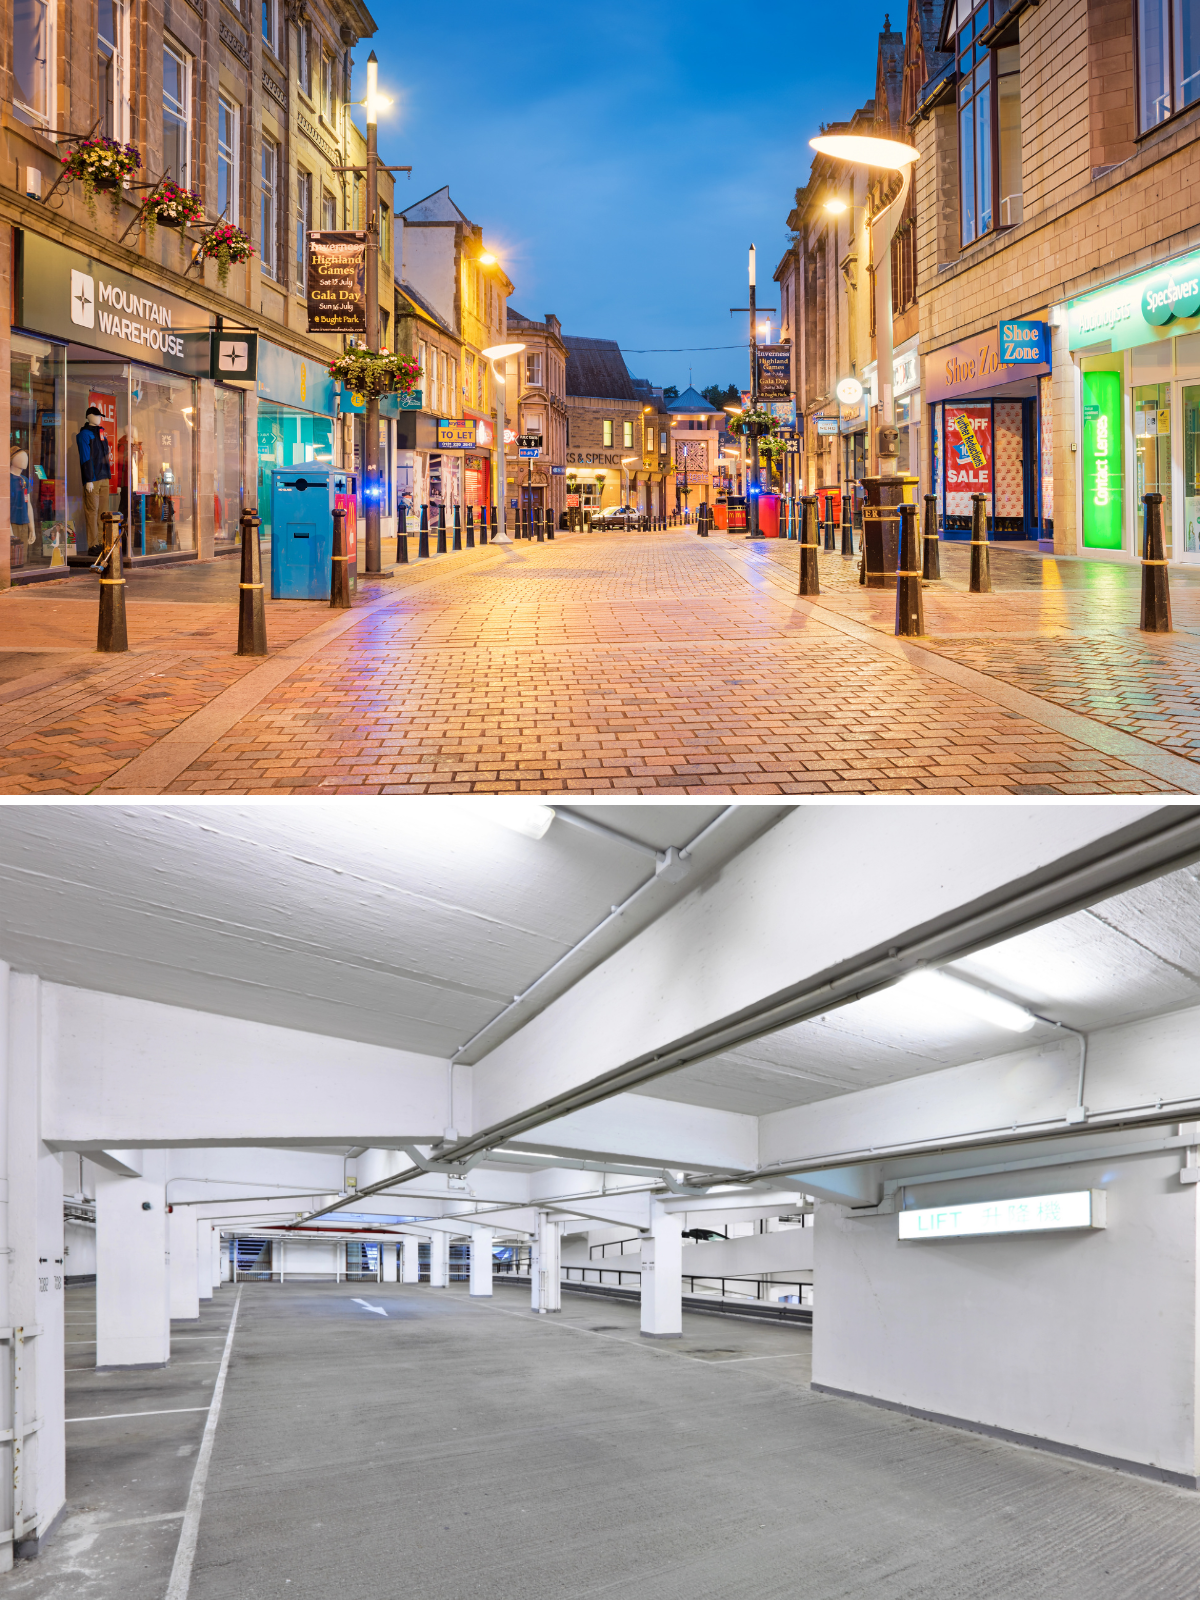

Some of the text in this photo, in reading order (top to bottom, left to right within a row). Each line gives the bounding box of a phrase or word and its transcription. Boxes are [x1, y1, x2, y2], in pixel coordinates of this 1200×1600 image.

[310, 241, 364, 252] Inverness
[312, 255, 362, 266] Highland
[318, 265, 355, 275] Games
[338, 278, 353, 288] July
[311, 290, 361, 303] Gala Day
[1146, 278, 1199, 313] Specsavers
[98, 281, 171, 328] MOUNTAIN
[339, 301, 354, 312] July
[320, 314, 342, 325] Bught
[343, 314, 360, 323] Park
[97, 310, 184, 358] WAREHOUSE
[1003, 324, 1039, 341] Shoe
[1004, 343, 1040, 359] Zone
[759, 358, 789, 366] Highland
[945, 357, 976, 386] Shoe
[441, 431, 473, 439] TO LET
[955, 414, 984, 468] Further Reductions
[578, 453, 585, 464] &
[1094, 414, 1109, 506] Contact Lenses
[947, 469, 989, 483] SALE
[918, 1211, 962, 1231] LIFT
[982, 1201, 1061, 1227] 升降機
